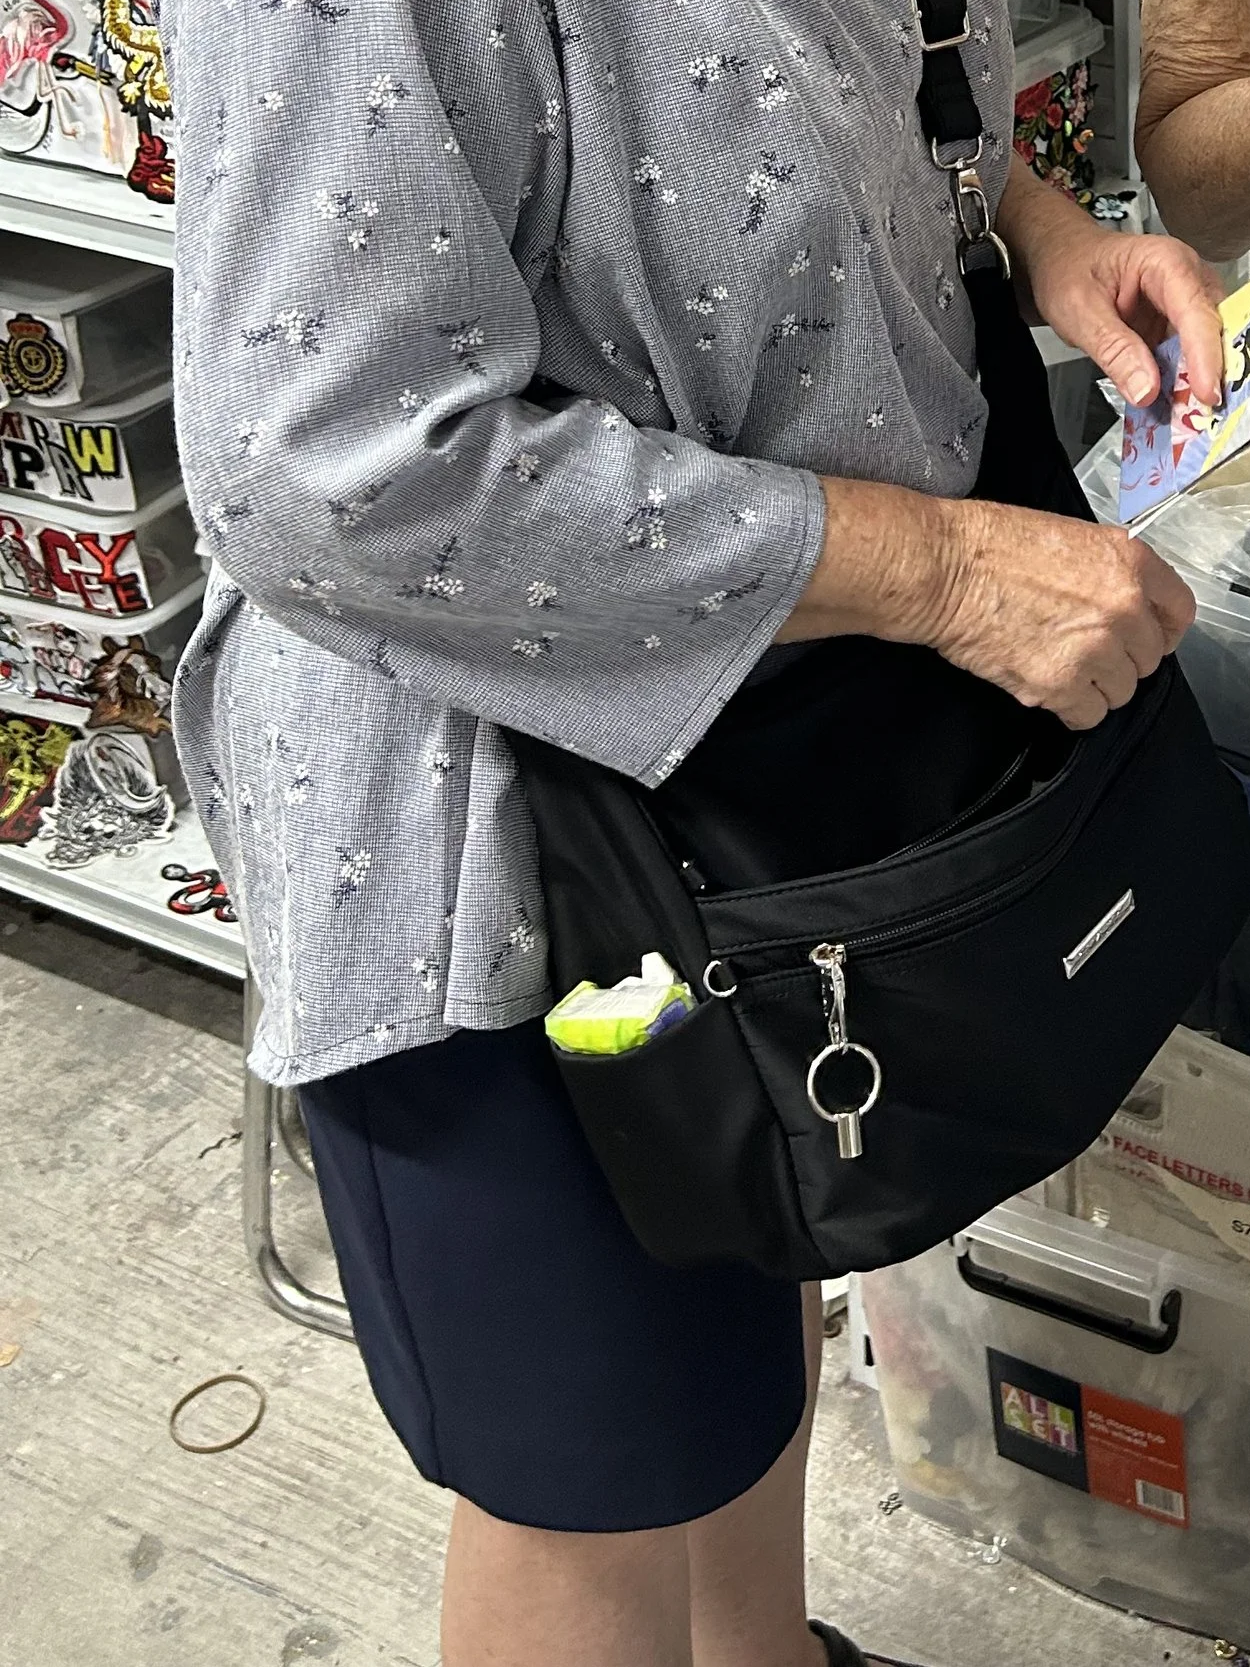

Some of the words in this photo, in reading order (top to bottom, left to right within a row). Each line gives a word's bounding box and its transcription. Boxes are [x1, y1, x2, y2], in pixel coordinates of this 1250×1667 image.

[1112, 1135, 1159, 1166] FACE
[1162, 1155, 1244, 1198] LETTERS
[1004, 1387, 1074, 1426] ALL
[1004, 1403, 1075, 1447] SET
